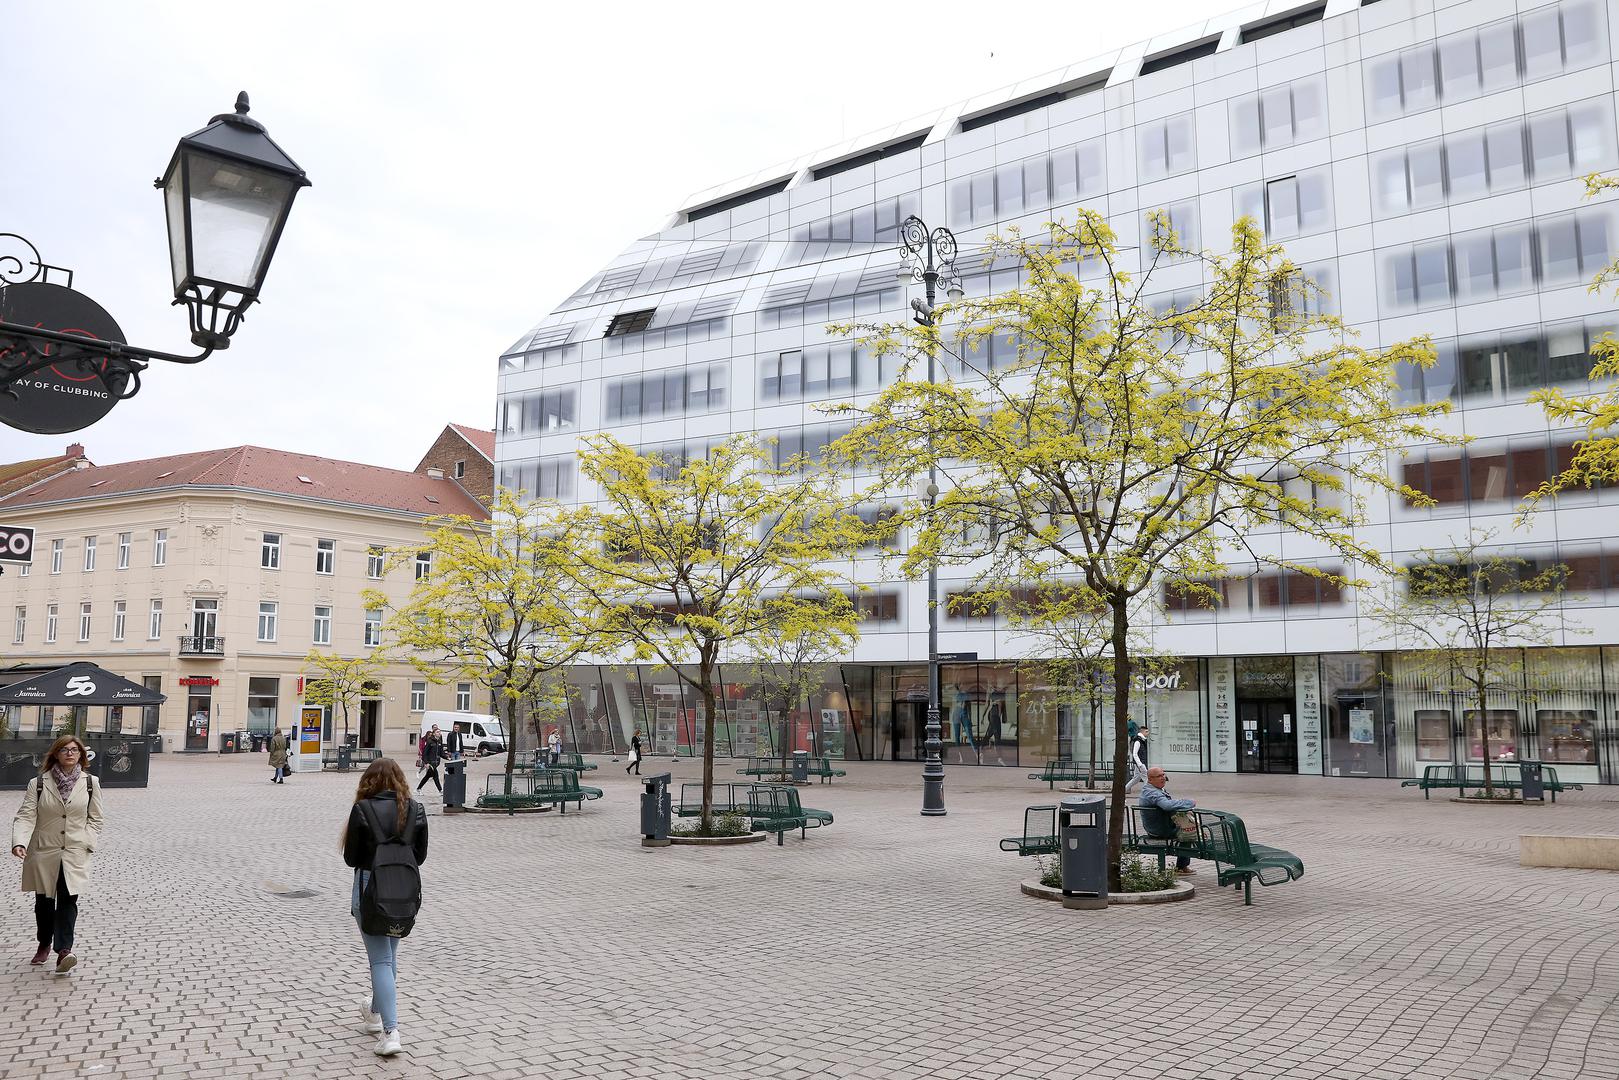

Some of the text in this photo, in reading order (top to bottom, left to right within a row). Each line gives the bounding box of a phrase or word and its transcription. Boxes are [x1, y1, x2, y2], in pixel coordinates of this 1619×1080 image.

[34, 381, 49, 389] OF
[53, 384, 108, 398] CLUBBING
[64, 676, 96, 697] 50
[1135, 670, 1180, 691] sport
[14, 690, 46, 698] Jamnica
[112, 691, 141, 699] Jamnica
